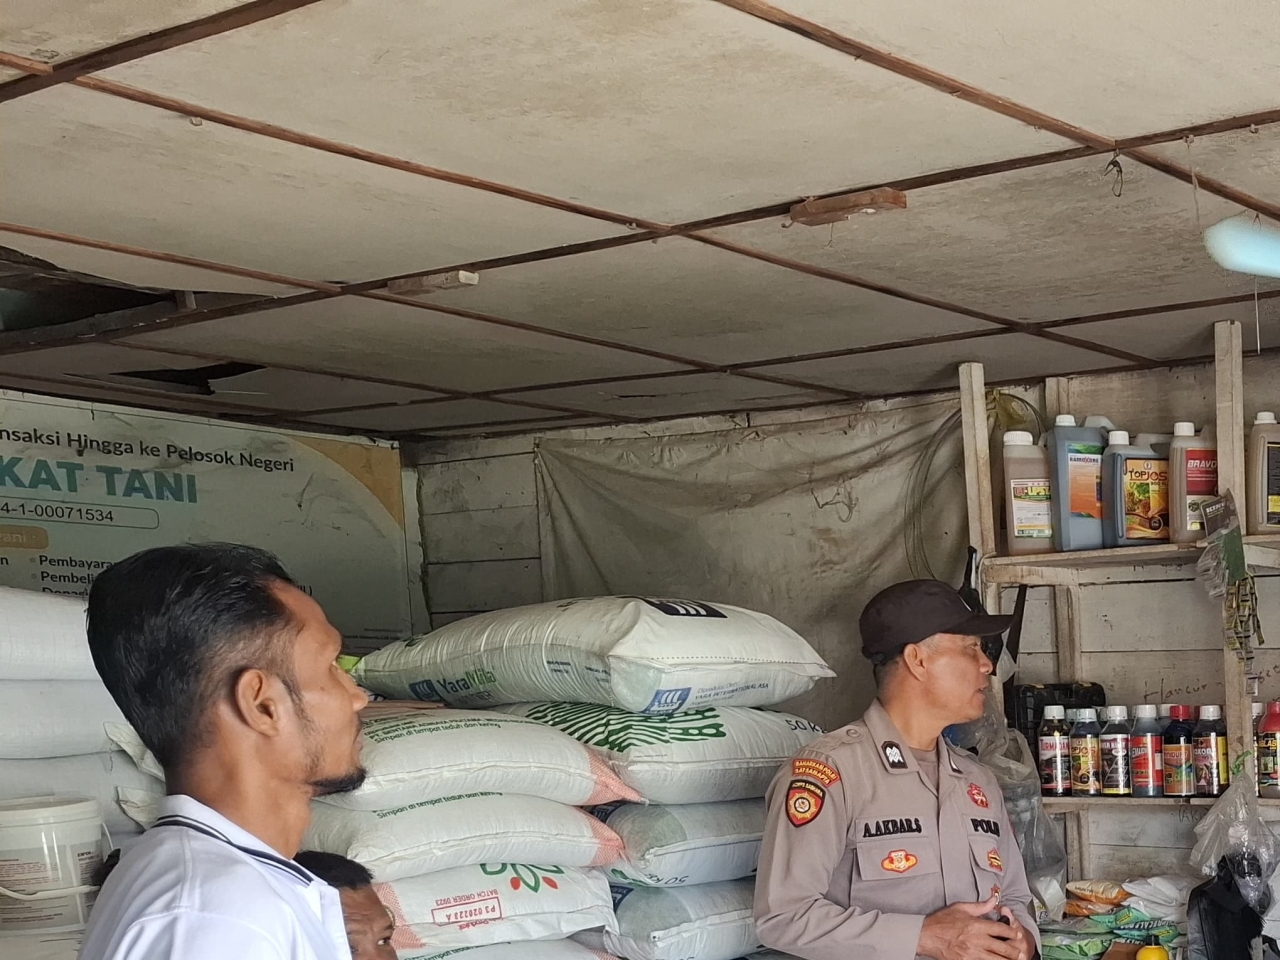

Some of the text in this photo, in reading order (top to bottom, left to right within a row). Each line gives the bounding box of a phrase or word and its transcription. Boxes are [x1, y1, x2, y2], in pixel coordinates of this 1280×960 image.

[66, 433, 135, 457] Hingga
[139, 441, 162, 457] ke
[166, 444, 236, 467] Pelosok
[239, 453, 295, 474] Negeri
[96, 465, 199, 504] TANI
[40, 570, 95, 585] Pembeli
[374, 730, 406, 744] Simpan
[405, 728, 414, 737] di
[414, 724, 443, 736] tempat
[442, 722, 463, 733] teduh
[463, 721, 478, 729] dan
[785, 718, 805, 732] 50
[376, 806, 408, 820] Simpan
[408, 802, 417, 811] di
[416, 797, 444, 809] tempat
